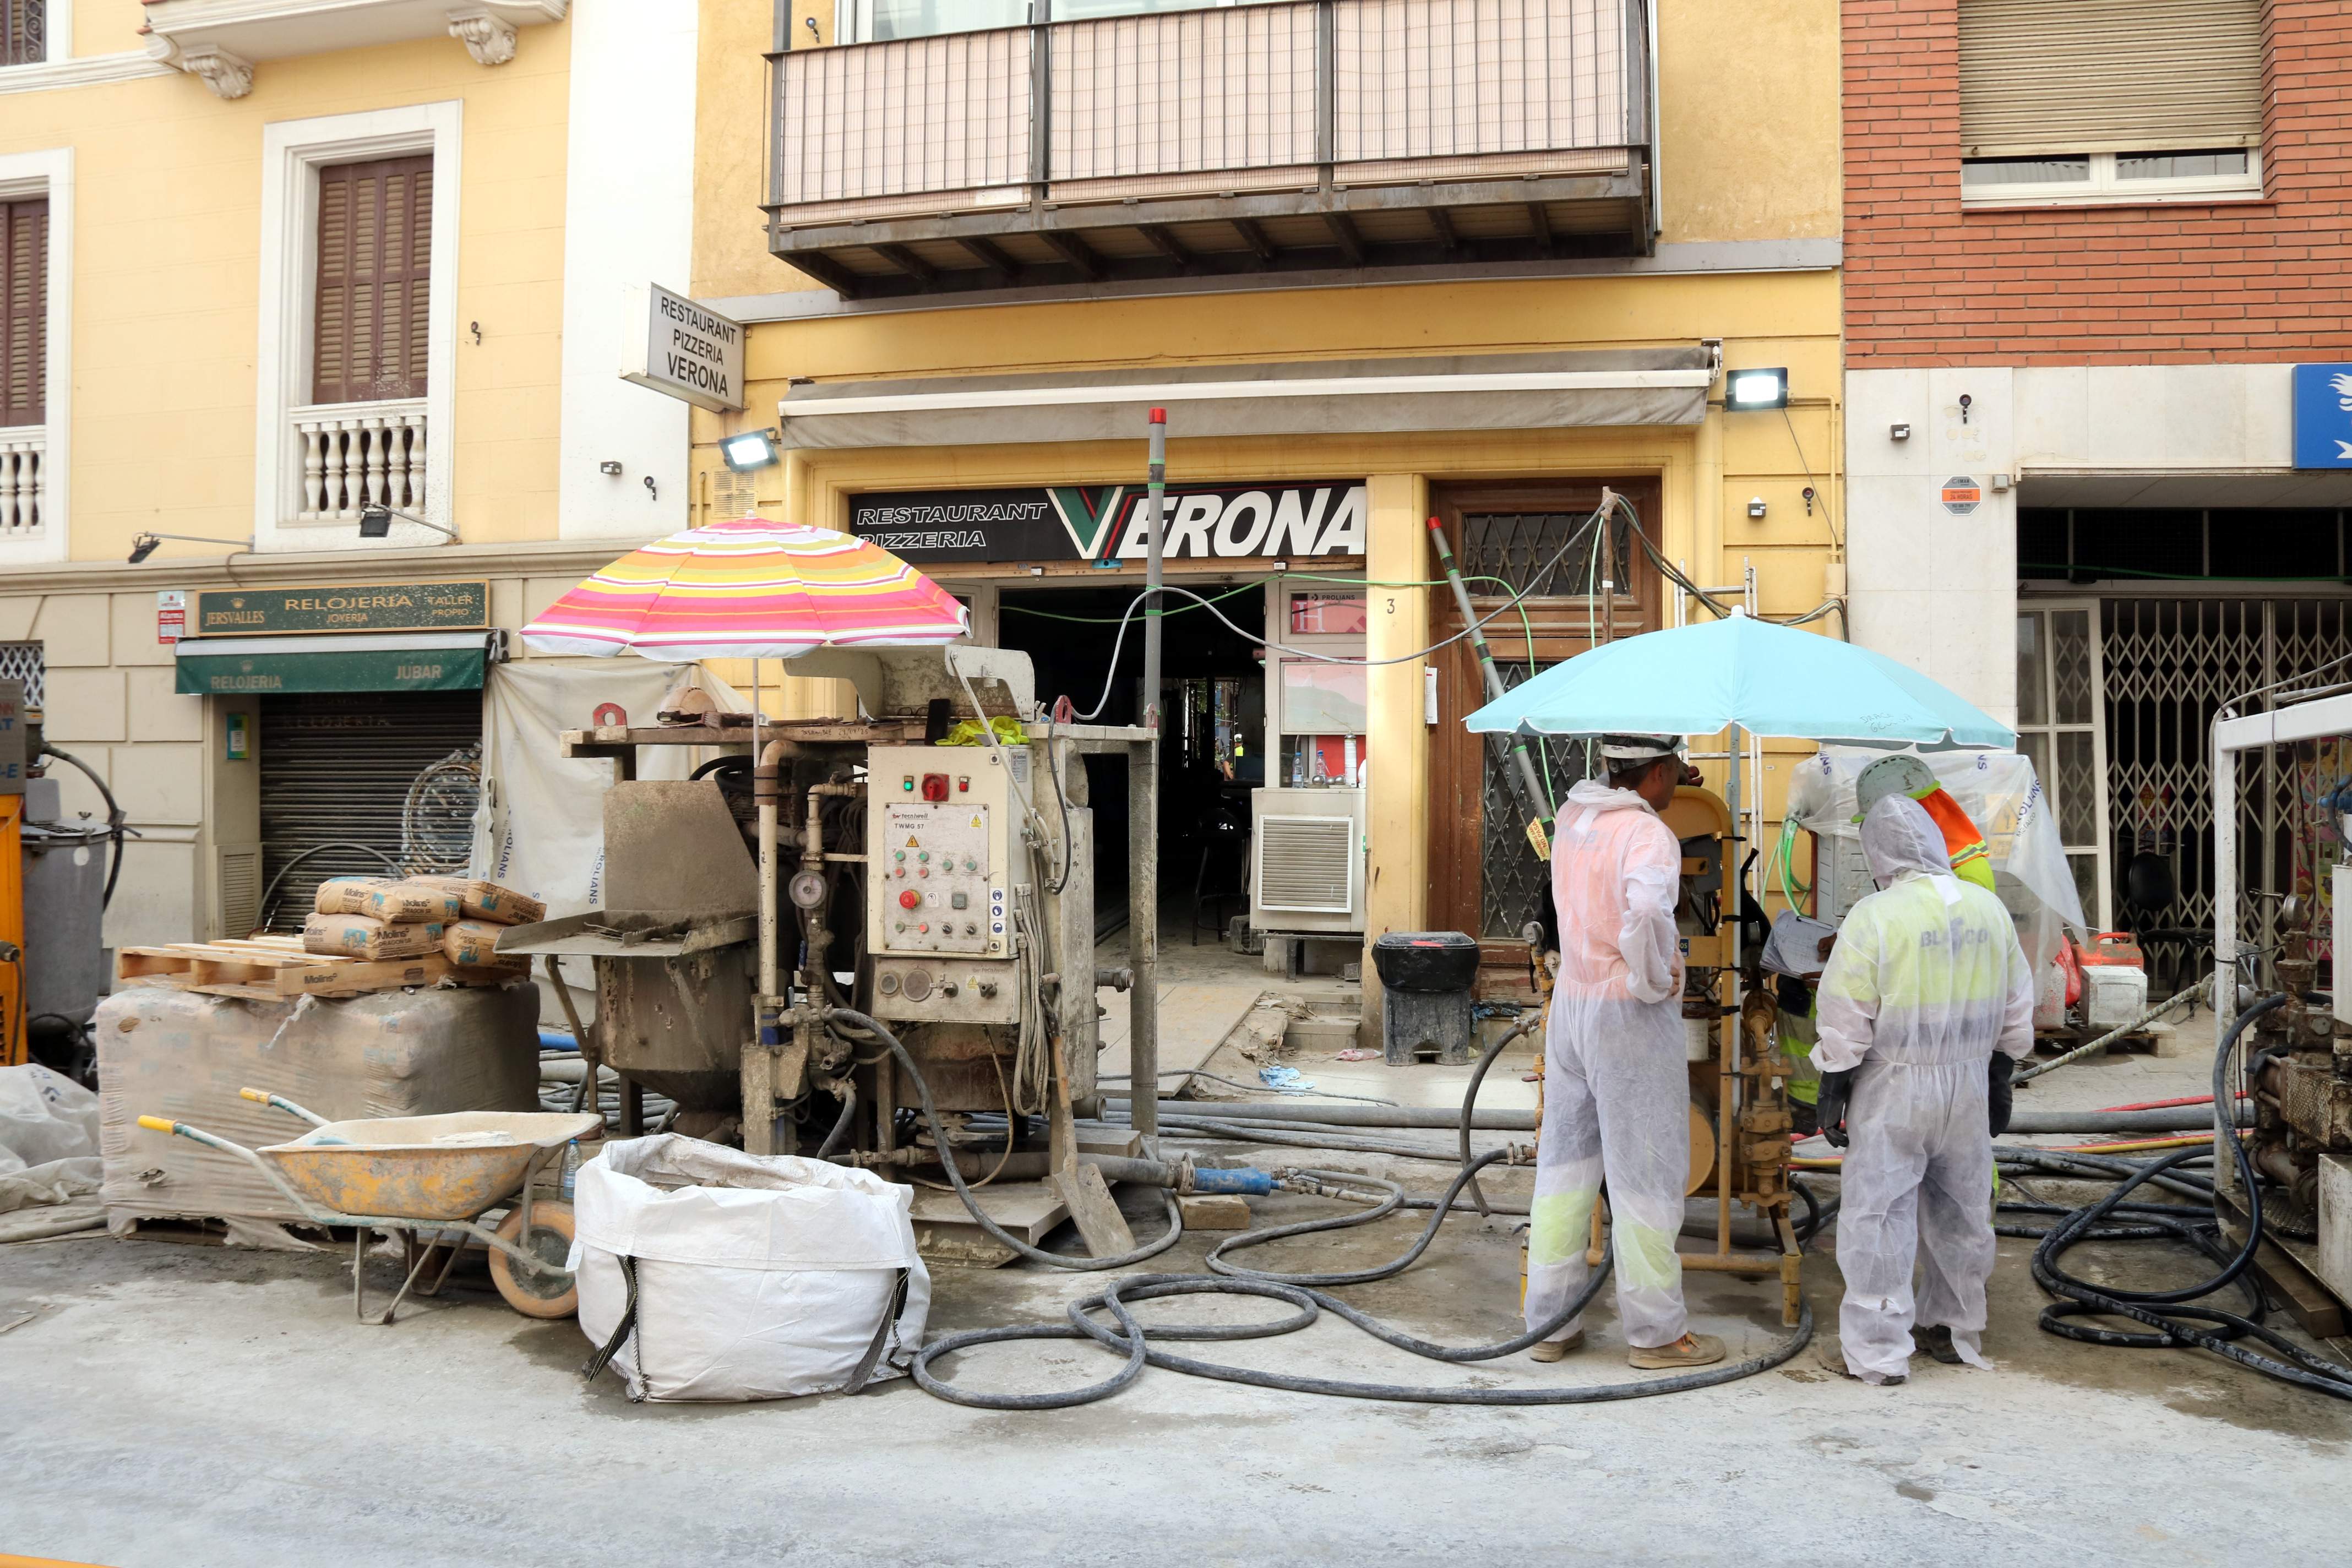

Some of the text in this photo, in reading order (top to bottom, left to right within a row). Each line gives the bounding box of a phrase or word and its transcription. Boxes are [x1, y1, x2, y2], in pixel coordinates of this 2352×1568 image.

[661, 296, 736, 345] RESTAURANT
[673, 328, 723, 366] PIZZERIA
[667, 351, 728, 398] VERONA
[857, 503, 1047, 525] RESTAURANT
[1046, 486, 1365, 559] VERONA
[858, 530, 986, 549] PIZZERIA
[285, 595, 474, 611] RELOJERIA TALLER
[1387, 598, 1395, 614] 3
[205, 611, 265, 626] JERSVALLES
[326, 613, 368, 623] JOYERIA
[210, 674, 282, 689] RELOJERIA
[396, 665, 442, 679] JUBAR
[1532, 820, 1548, 847] NO PASA
[2016, 812, 2036, 837] METALCO
[589, 854, 605, 905] ROLIANS
[344, 888, 364, 898] Molins
[378, 930, 406, 939] Molins
[1920, 928, 1989, 948] BLCO
[304, 976, 333, 984] Molins
